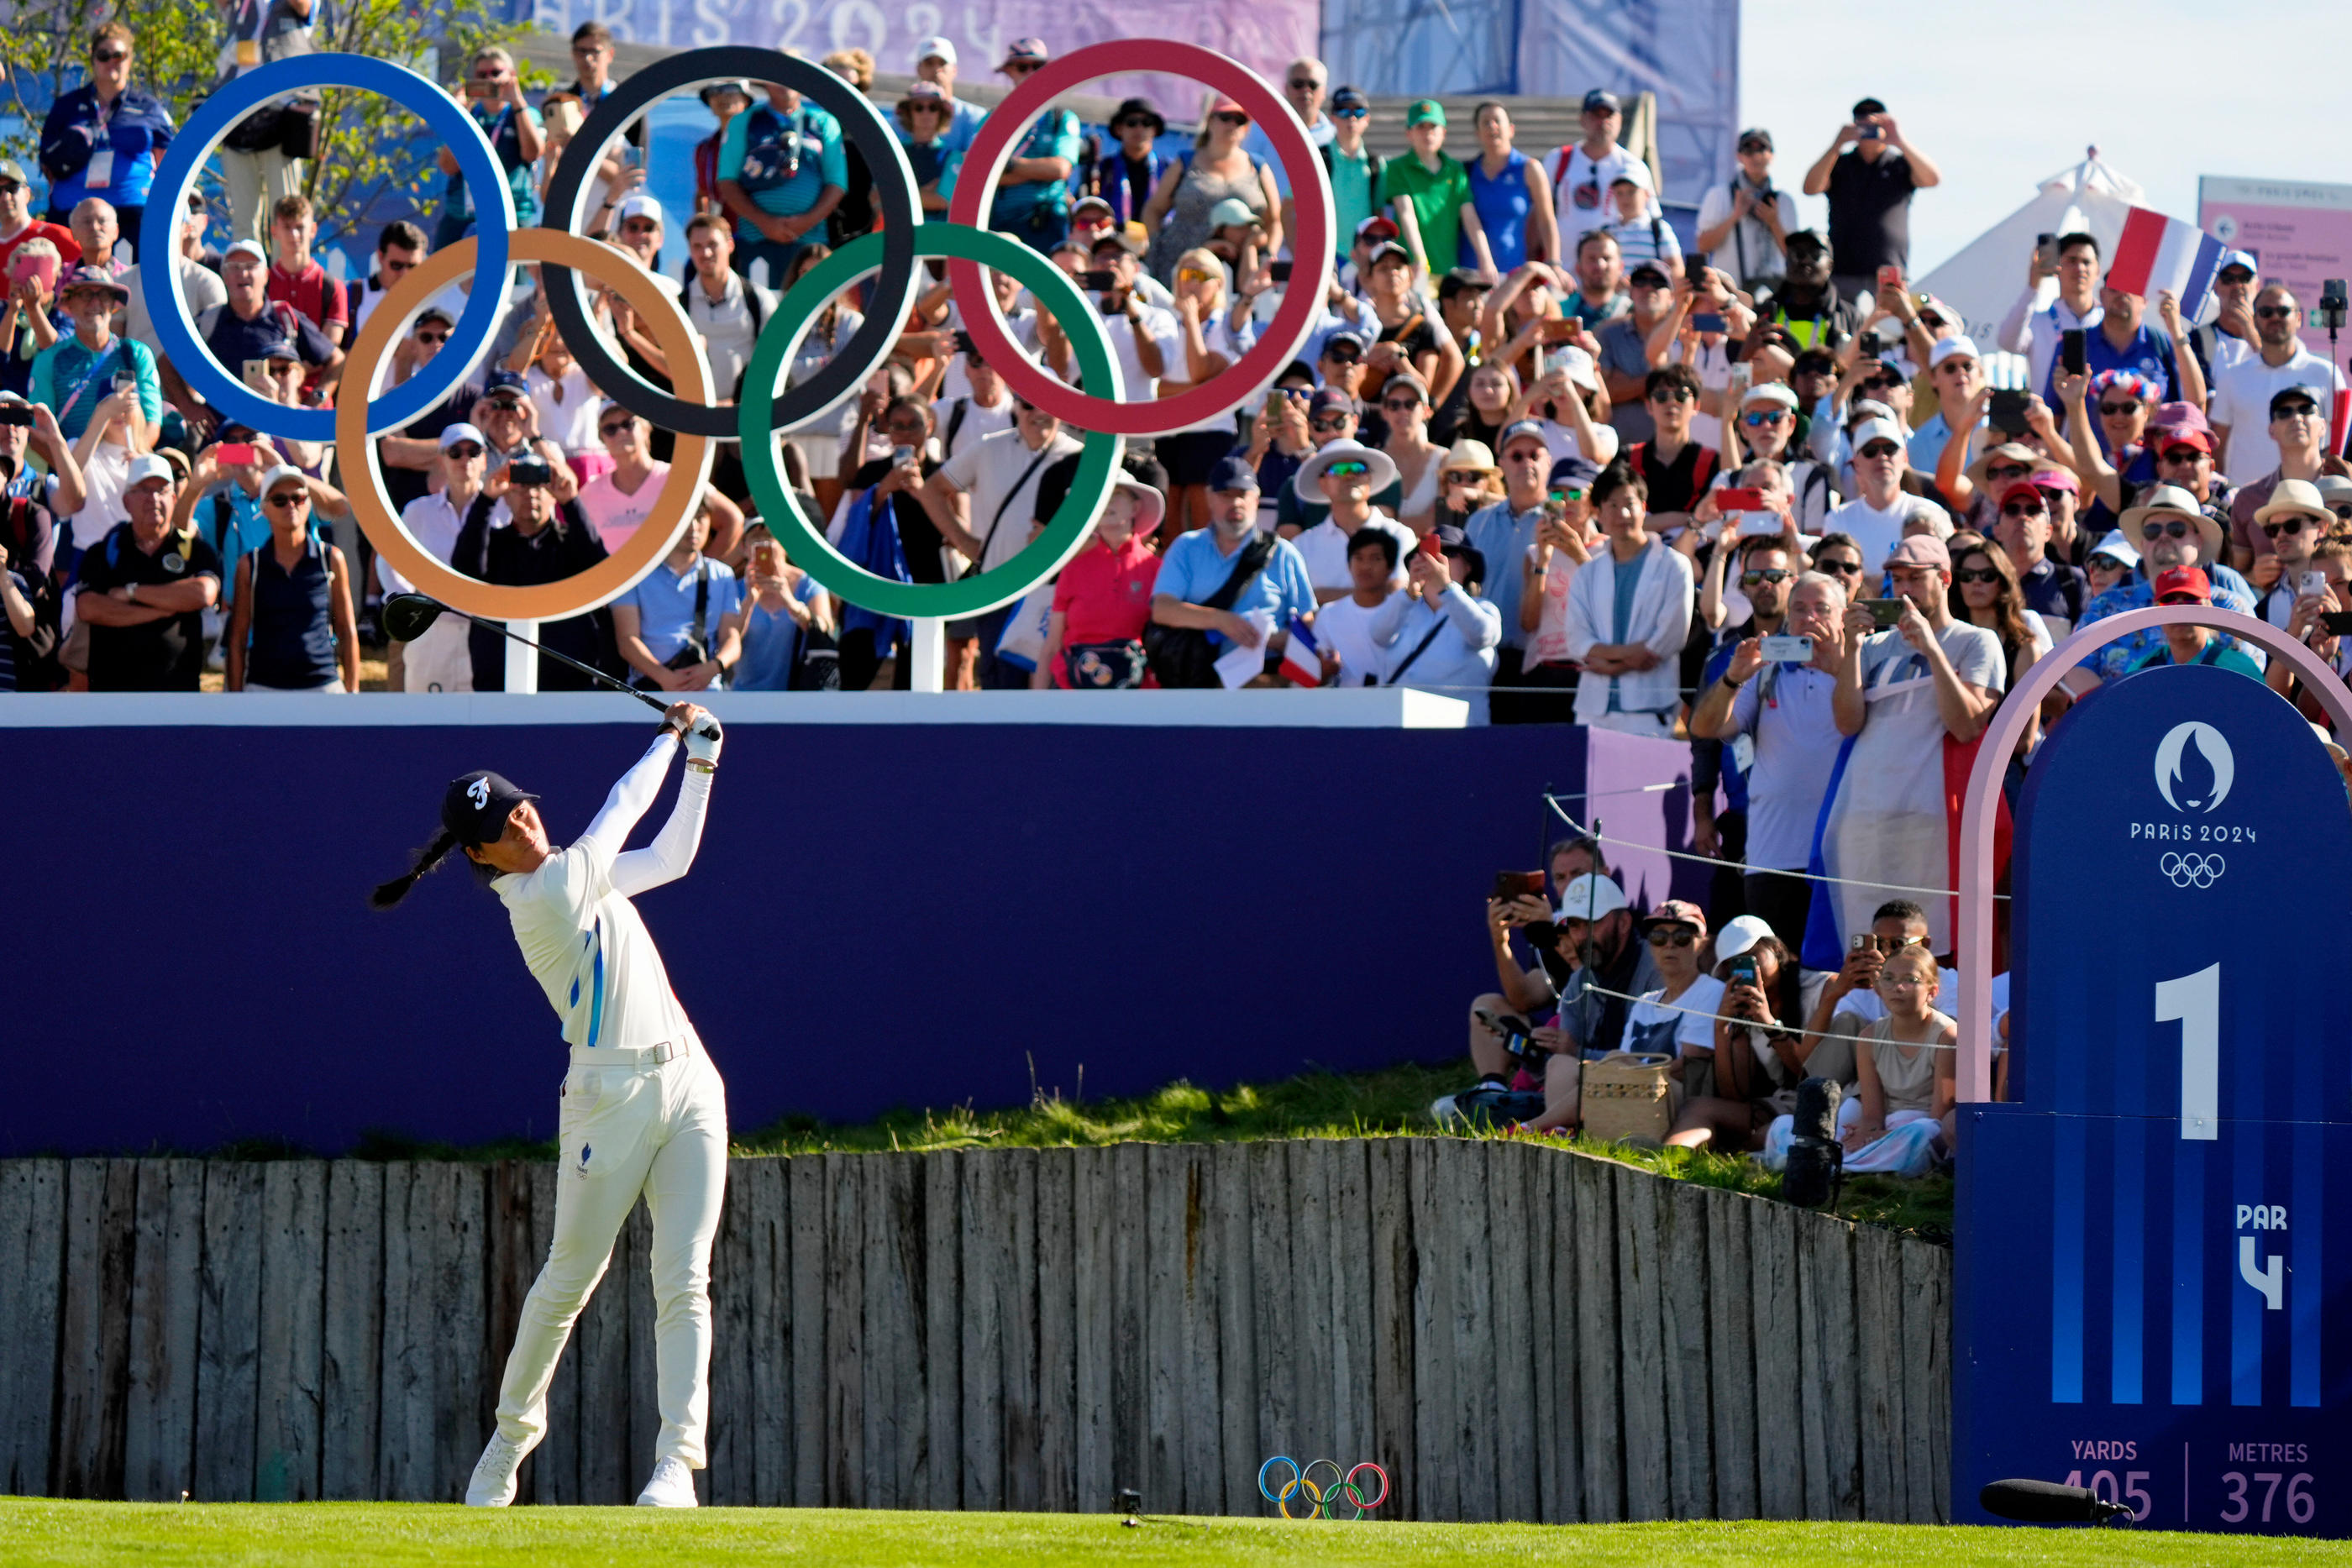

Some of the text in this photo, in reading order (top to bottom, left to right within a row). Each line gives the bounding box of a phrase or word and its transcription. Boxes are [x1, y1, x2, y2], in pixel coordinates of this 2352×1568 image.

[2200, 825, 2256, 843] 2024
[2155, 962, 2220, 1141] 1
[2236, 1204, 2288, 1230] PAR
[2239, 1236, 2283, 1310] 4
[2071, 1440, 2137, 1460] YARDS
[2229, 1443, 2308, 1462] METRES
[2220, 1471, 2316, 1524] 376
